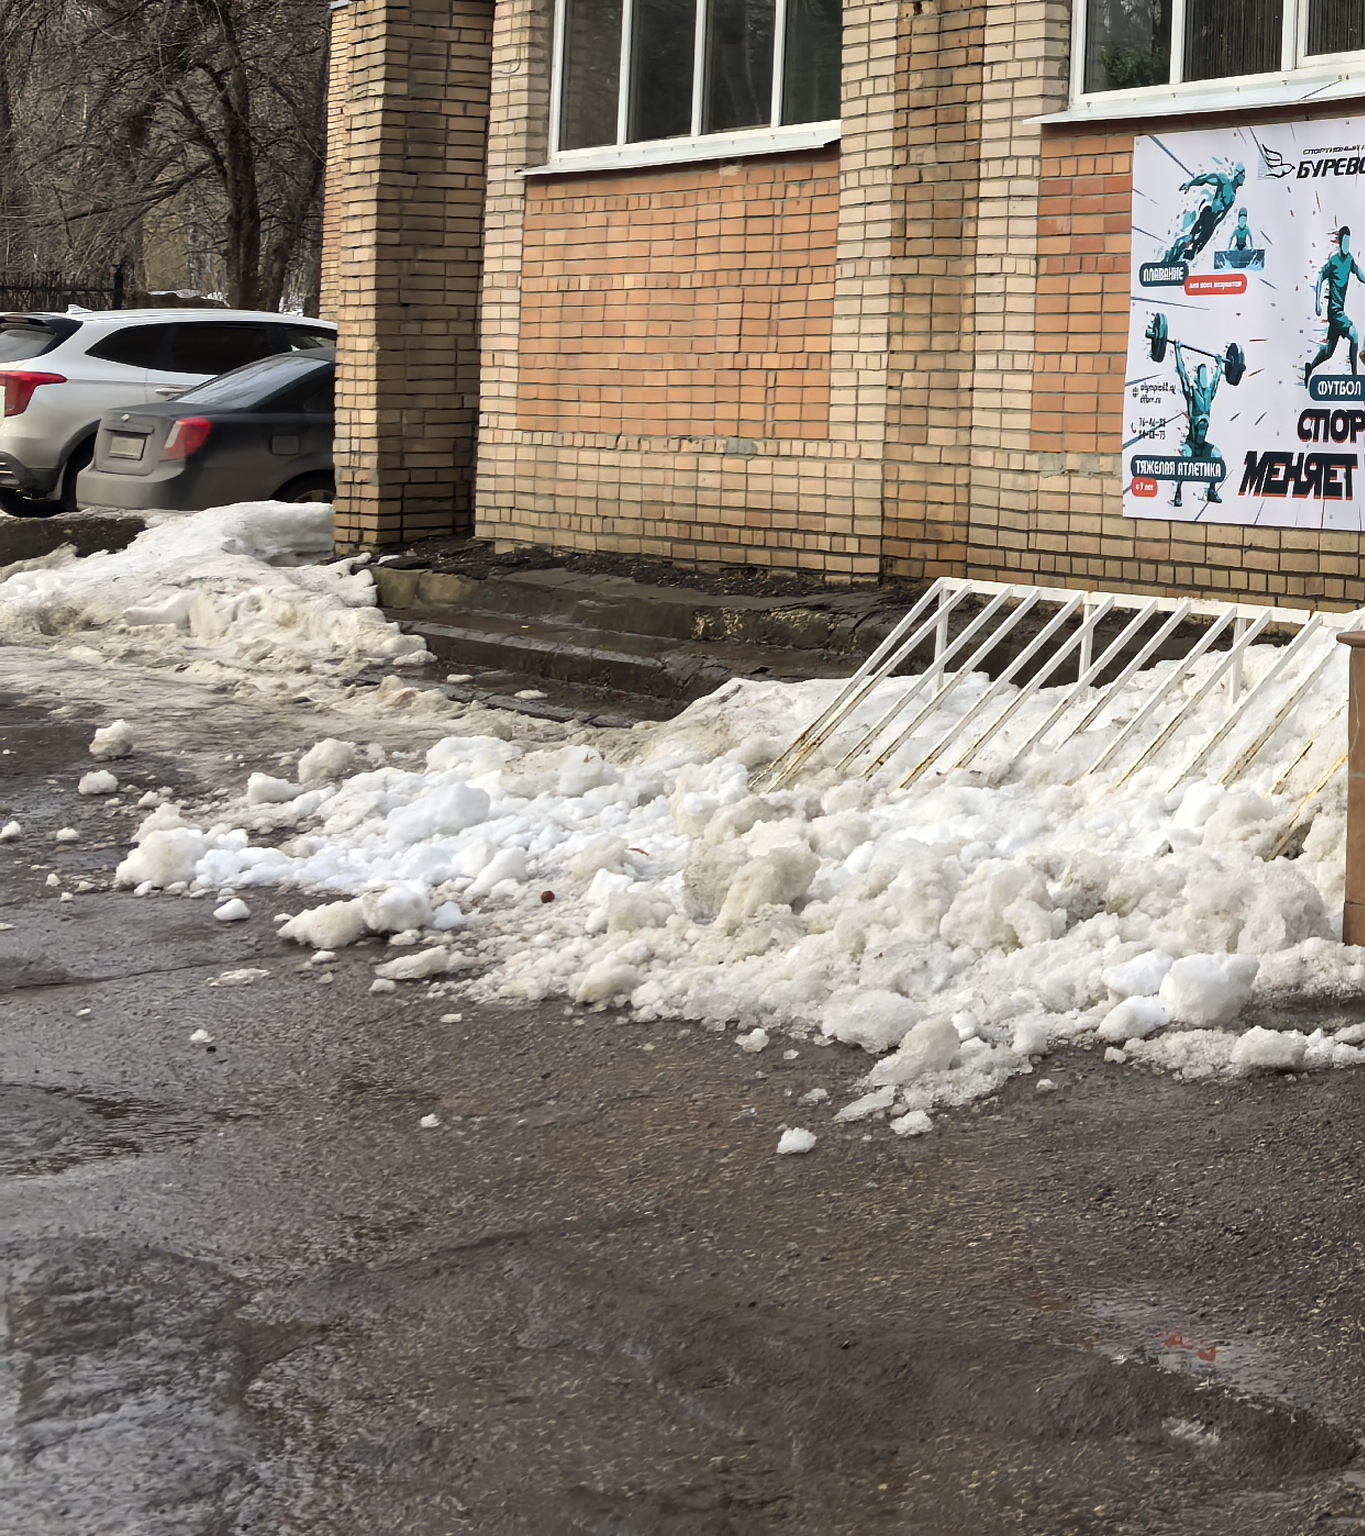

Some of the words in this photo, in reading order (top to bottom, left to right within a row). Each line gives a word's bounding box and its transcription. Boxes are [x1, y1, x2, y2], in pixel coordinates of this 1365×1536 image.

[1143, 267, 1184, 282] ПЛАВАНИЕ
[1317, 380, 1361, 395] ФУТБОЛ
[1178, 462, 1222, 478] АТЛЕТИКА
[1238, 450, 1358, 501] МЕНЯЕТ
